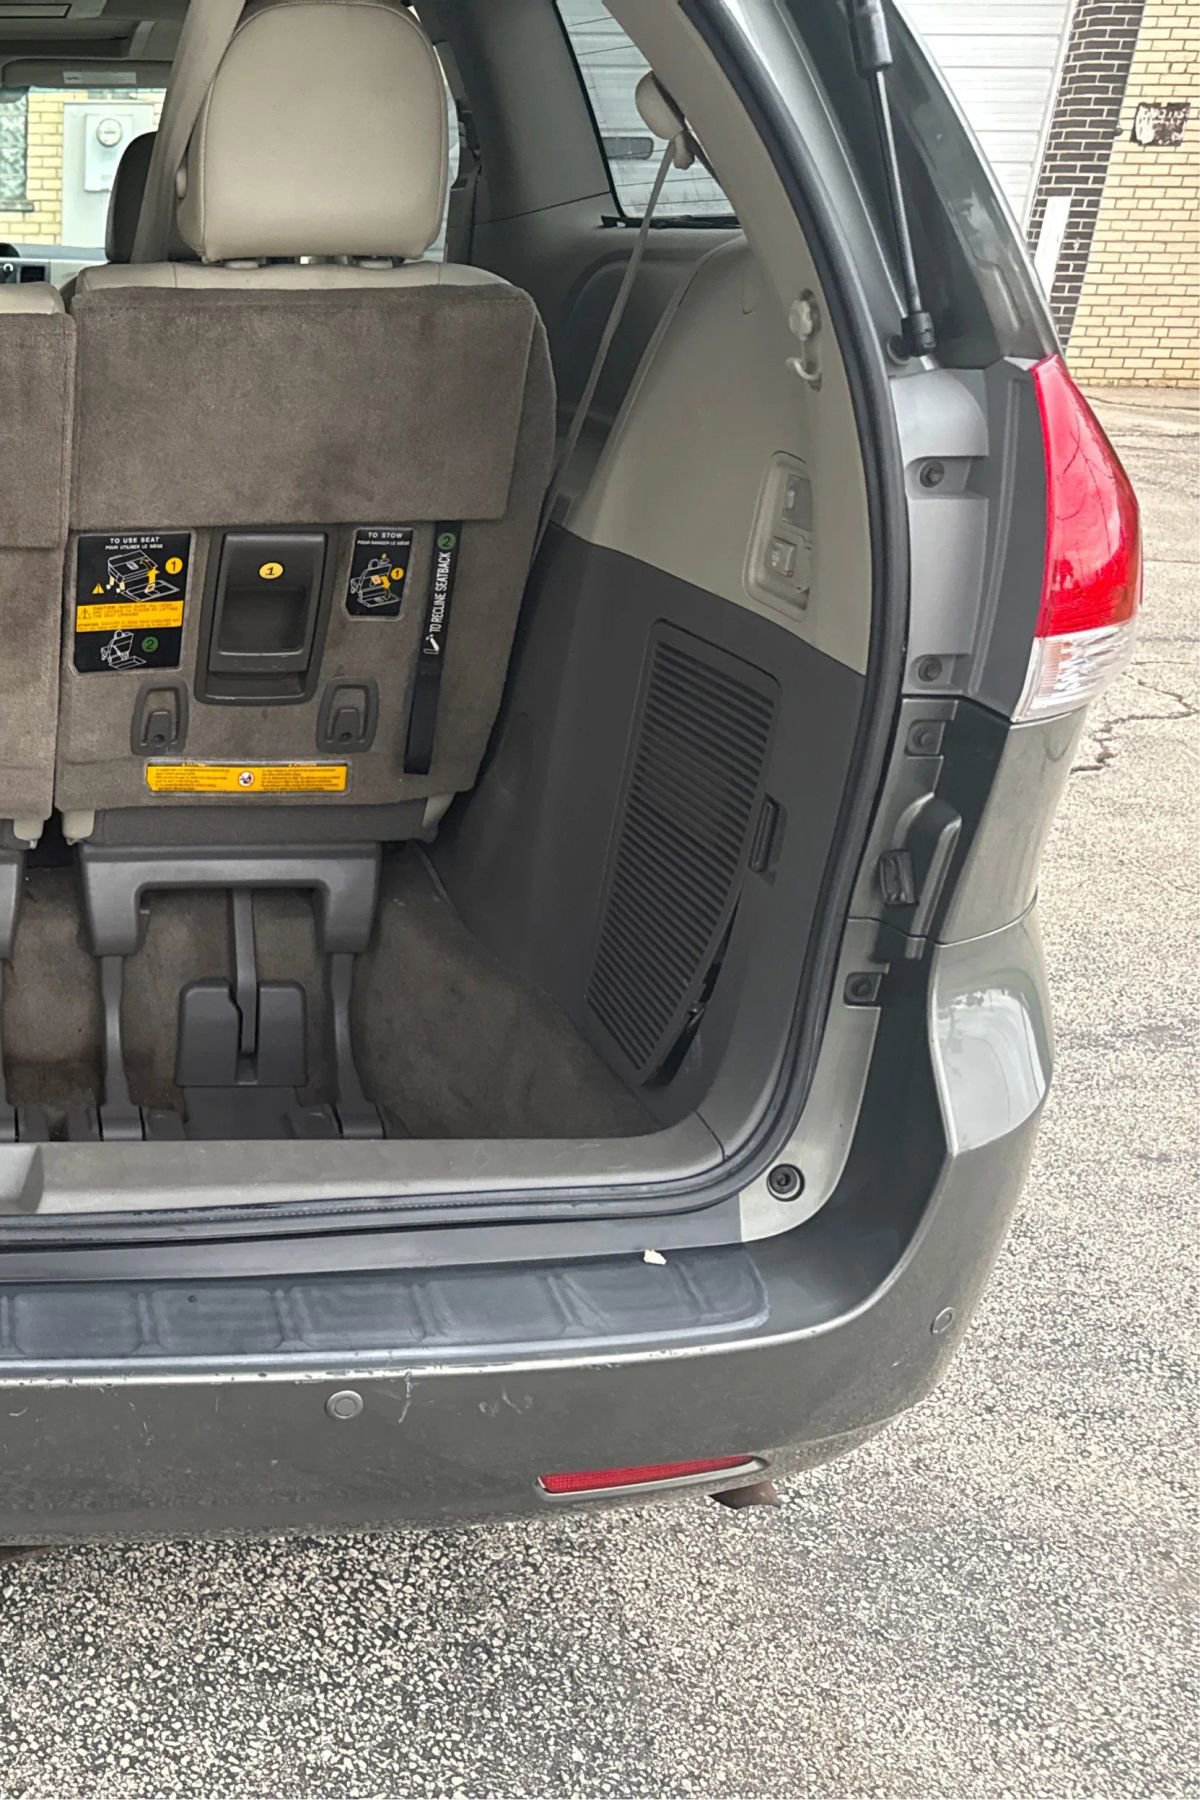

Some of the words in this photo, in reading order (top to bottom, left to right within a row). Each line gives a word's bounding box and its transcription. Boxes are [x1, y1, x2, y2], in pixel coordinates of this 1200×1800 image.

[435, 552, 451, 592] SEATBACK
[431, 592, 446, 623] RECLINE
[429, 624, 442, 633] TO
